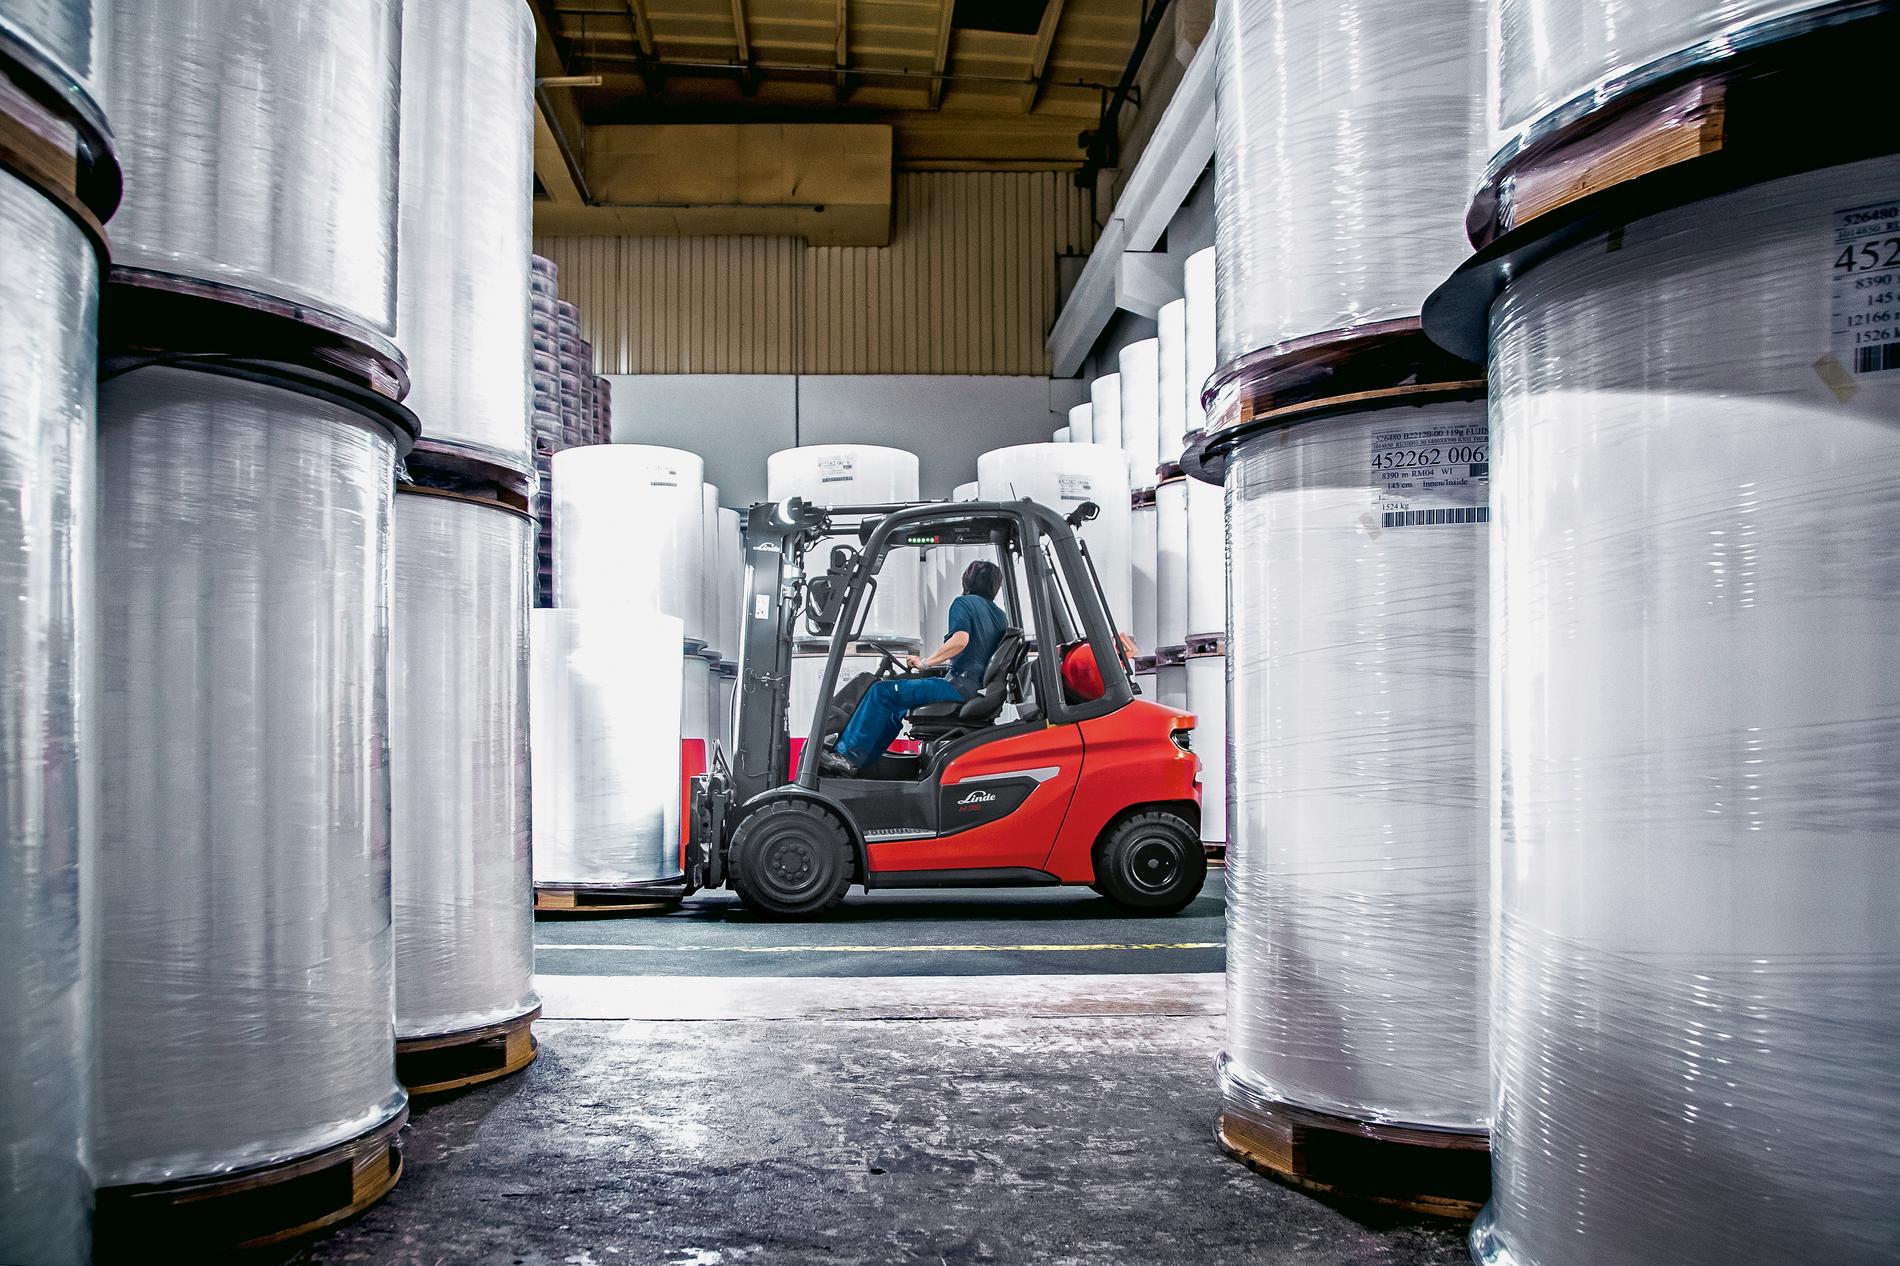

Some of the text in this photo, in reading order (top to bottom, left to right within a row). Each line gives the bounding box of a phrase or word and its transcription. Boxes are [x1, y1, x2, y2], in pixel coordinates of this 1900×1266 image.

[1834, 237, 1900, 272] 452
[1855, 274, 1892, 289] 8390
[1868, 291, 1893, 306] 145
[1848, 310, 1891, 327] 12166
[1856, 329, 1890, 343] 1526
[1376, 433, 1402, 443] 526480
[1446, 429, 1464, 437] 119g
[1371, 448, 1441, 470] 452262
[1381, 472, 1399, 480] 8390
[1411, 469, 1434, 477] RM04
[1387, 482, 1400, 490] 145
[1422, 478, 1469, 488] Innen/Inside
[1382, 502, 1409, 511] 1524 kg
[957, 790, 996, 804] Linde
